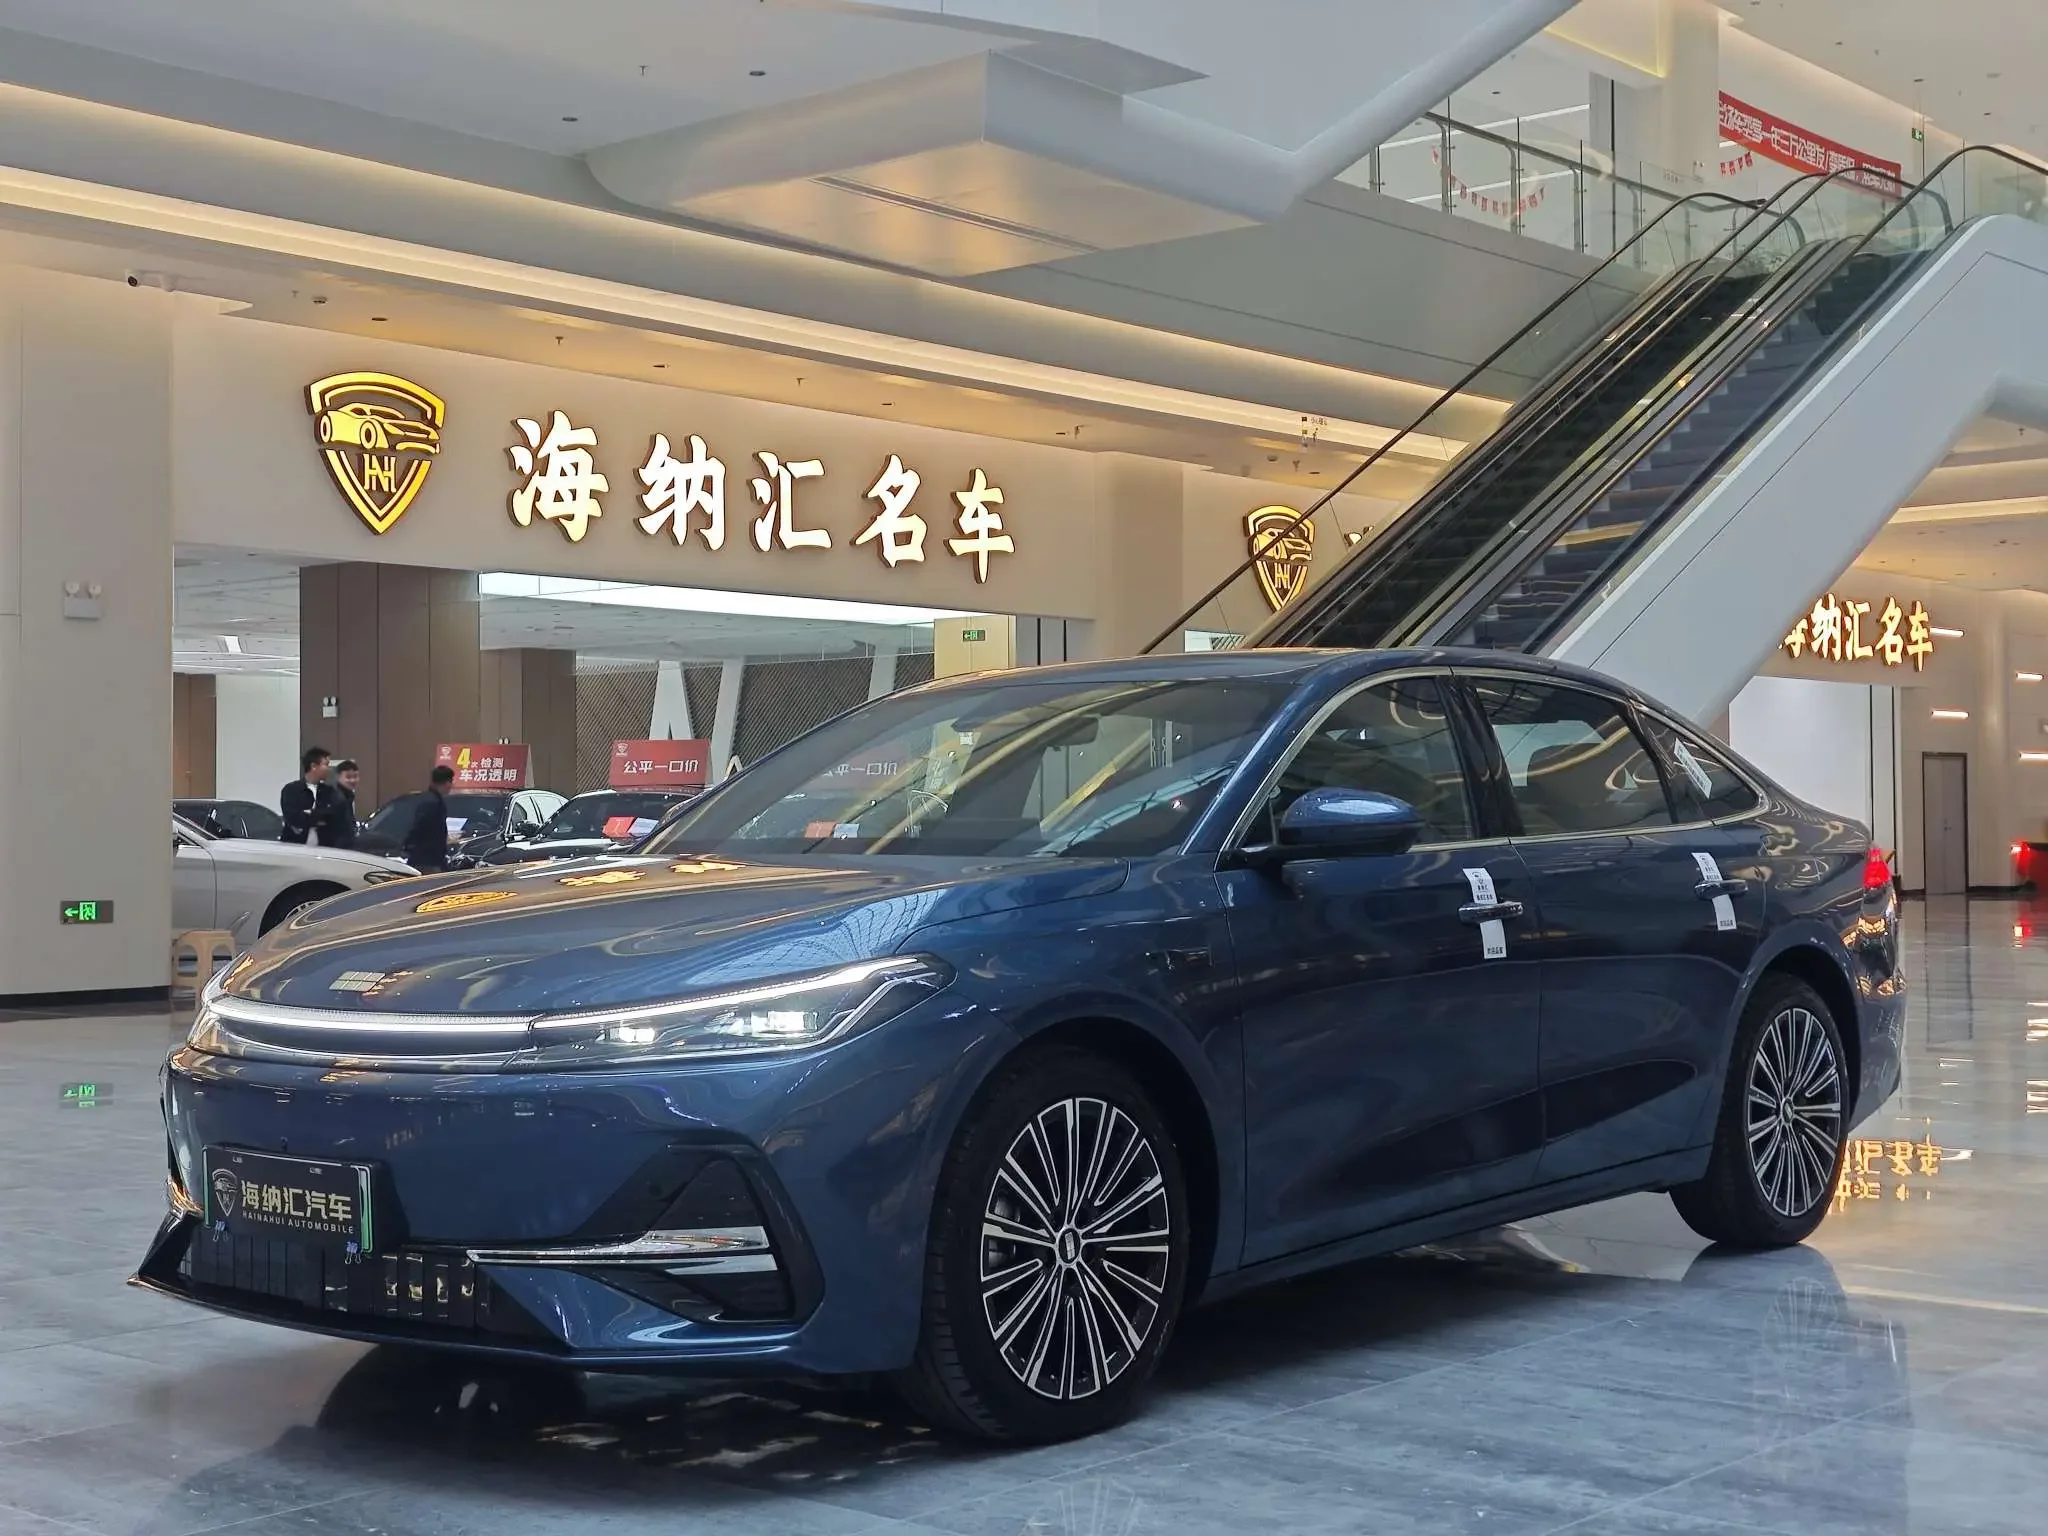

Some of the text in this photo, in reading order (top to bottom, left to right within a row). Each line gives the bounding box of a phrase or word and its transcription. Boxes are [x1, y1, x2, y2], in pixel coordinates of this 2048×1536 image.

[505, 409, 1016, 585] 海纳汇名车
[459, 769, 517, 782] 车况透明
[623, 759, 699, 774] 公平一口价
[240, 1179, 352, 1221] 海纳汇汽车
[242, 1210, 354, 1235] HAINAHUI AUTOMOBILE
